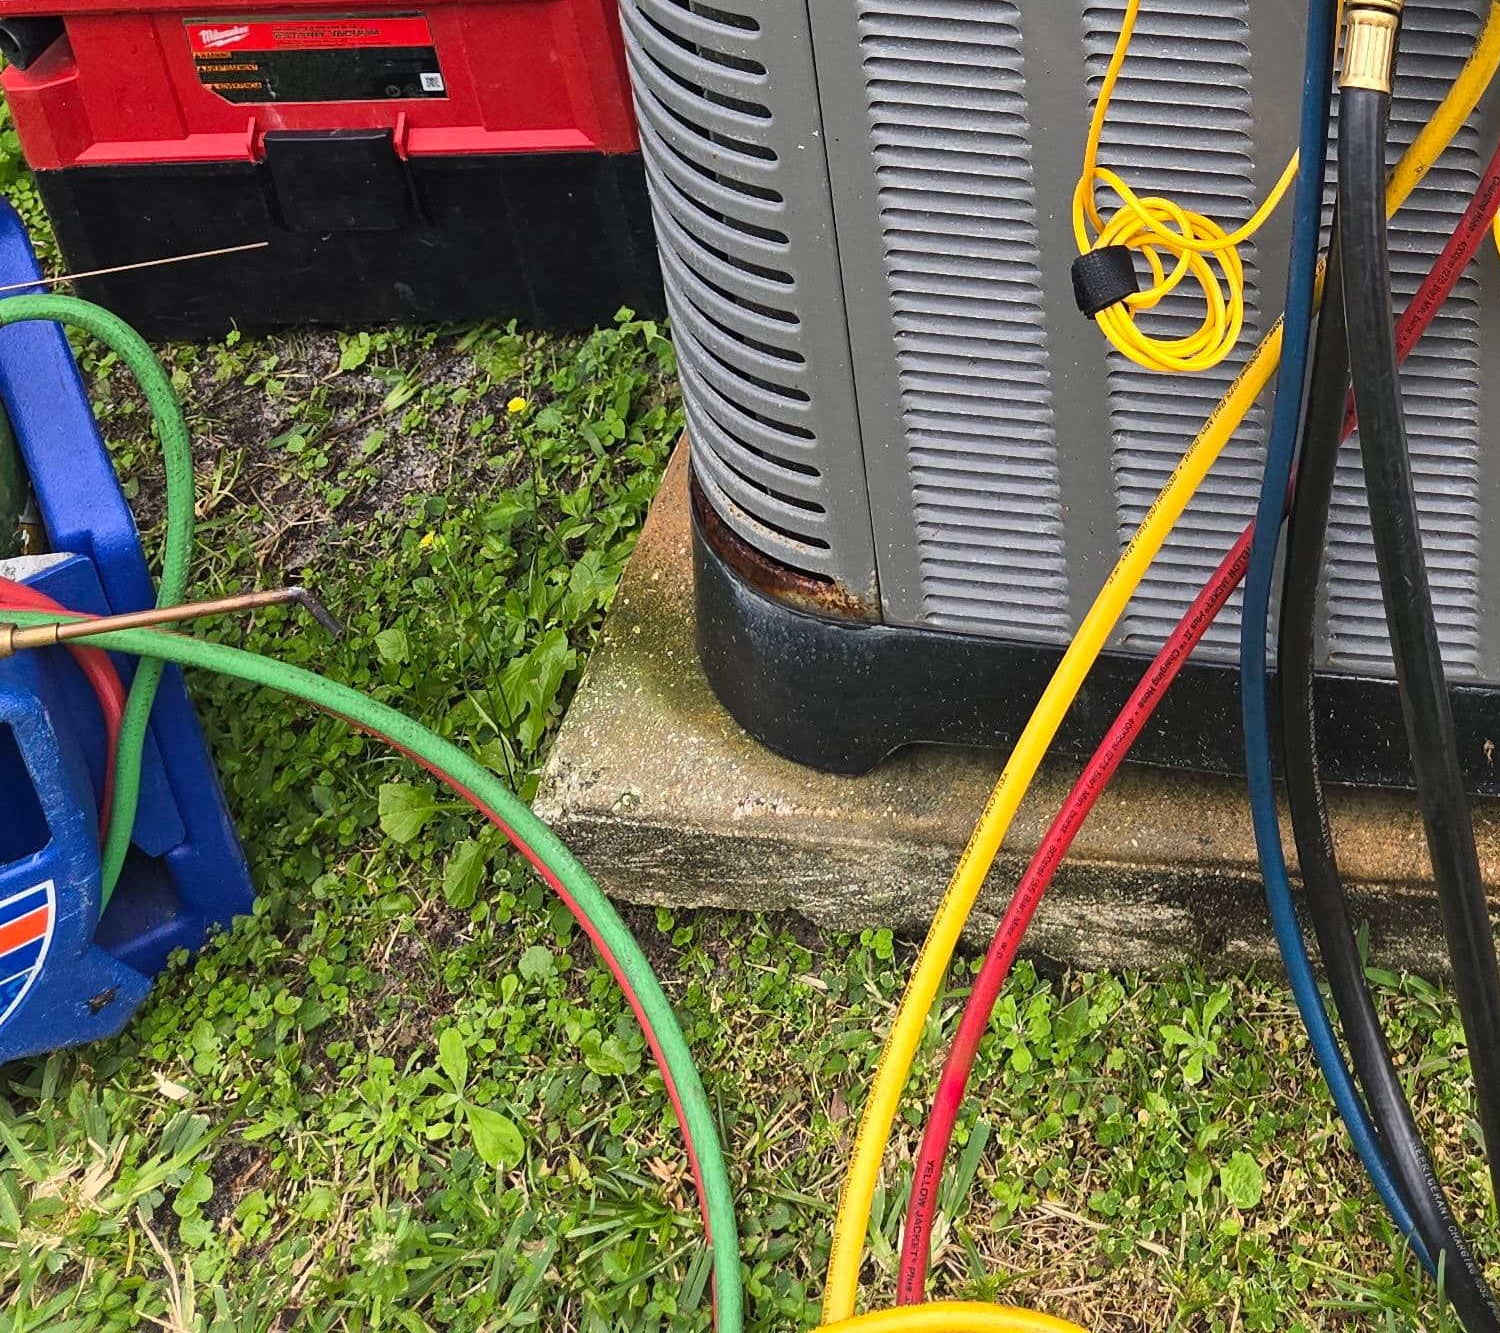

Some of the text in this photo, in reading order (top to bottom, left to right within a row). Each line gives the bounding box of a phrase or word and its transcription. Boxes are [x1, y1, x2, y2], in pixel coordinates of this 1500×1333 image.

[1208, 577, 1230, 609] JACKET
[1190, 611, 1207, 630] Plus
[1152, 648, 1180, 687] Charging
[1138, 686, 1156, 709] Hose
[984, 772, 1009, 818] YELLOW
[962, 821, 985, 865] JACKET
[947, 874, 961, 896] Plus
[918, 1159, 936, 1208] YELLOW
[1411, 1141, 1478, 1275] REFRIGERANT CHARGING
[910, 1211, 922, 1256] JACKET
